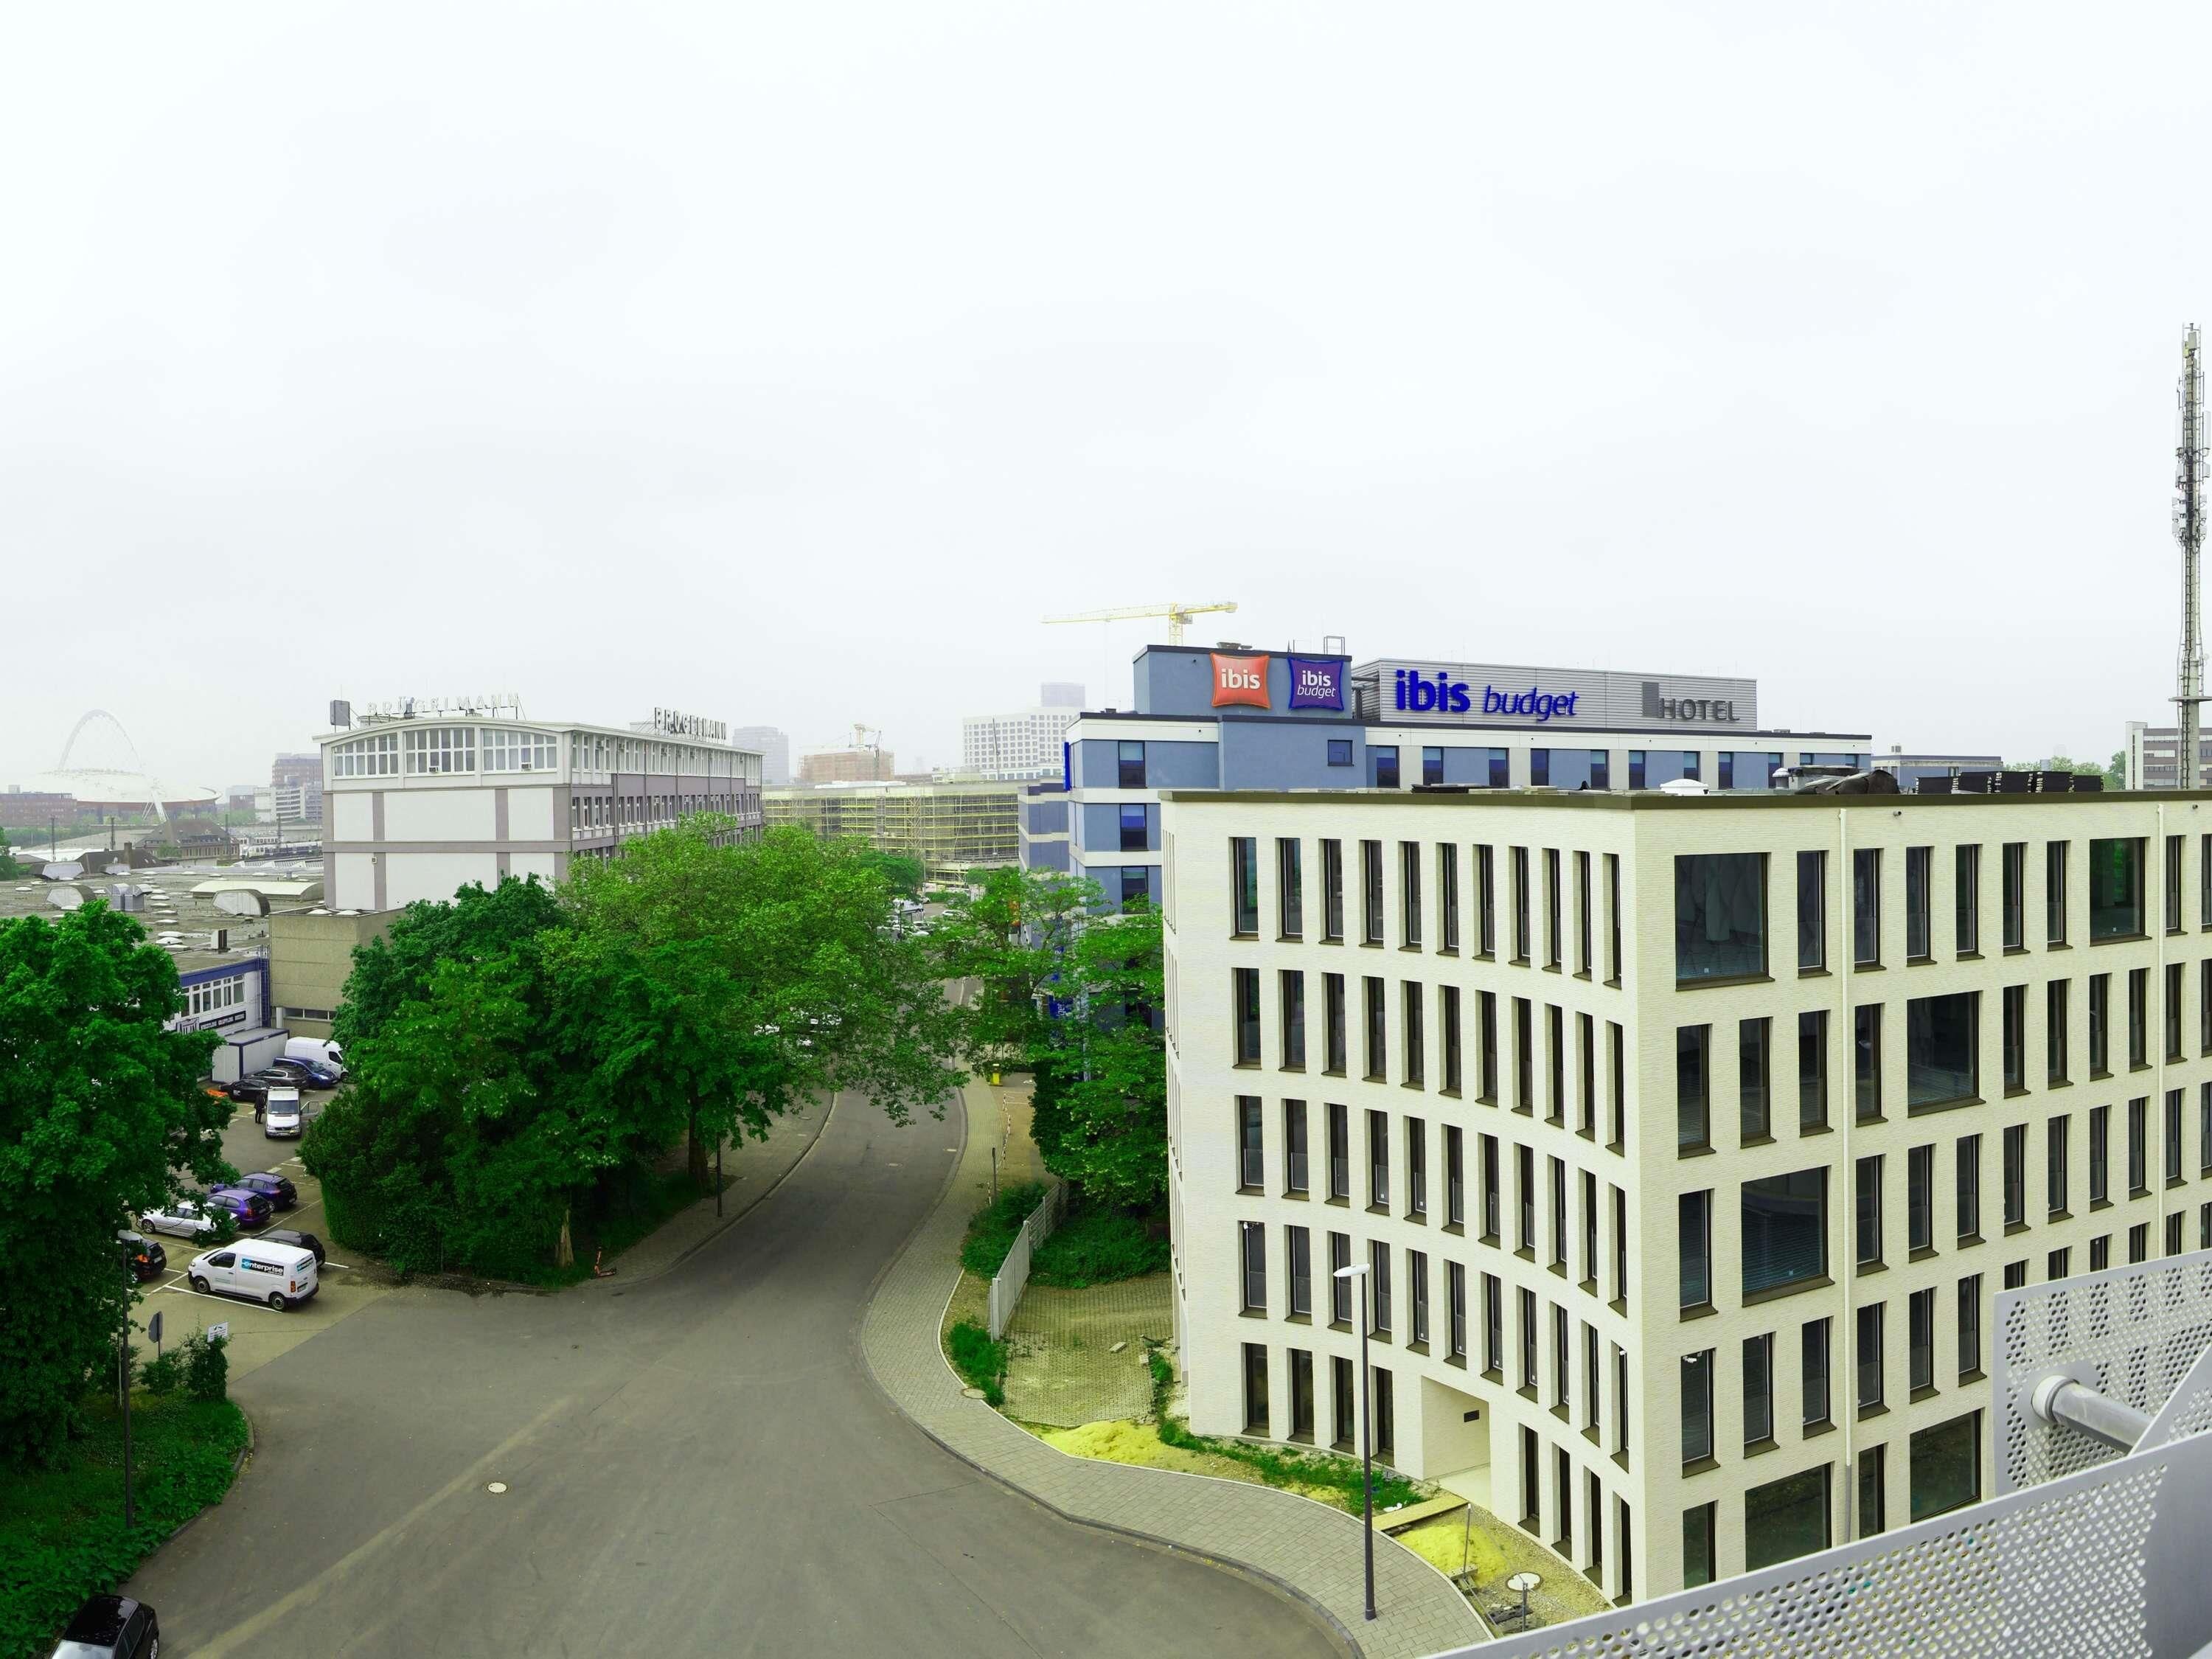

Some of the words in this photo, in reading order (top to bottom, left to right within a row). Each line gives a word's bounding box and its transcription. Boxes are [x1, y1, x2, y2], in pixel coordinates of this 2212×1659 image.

[1220, 668, 1262, 689] ibis
[1301, 669, 1332, 686] ibis
[1296, 684, 1337, 699] budget
[1395, 669, 1471, 712] ibis
[1484, 684, 1580, 722] budget
[1658, 698, 1740, 720] HOTEL
[243, 1261, 283, 1273] enterprise
